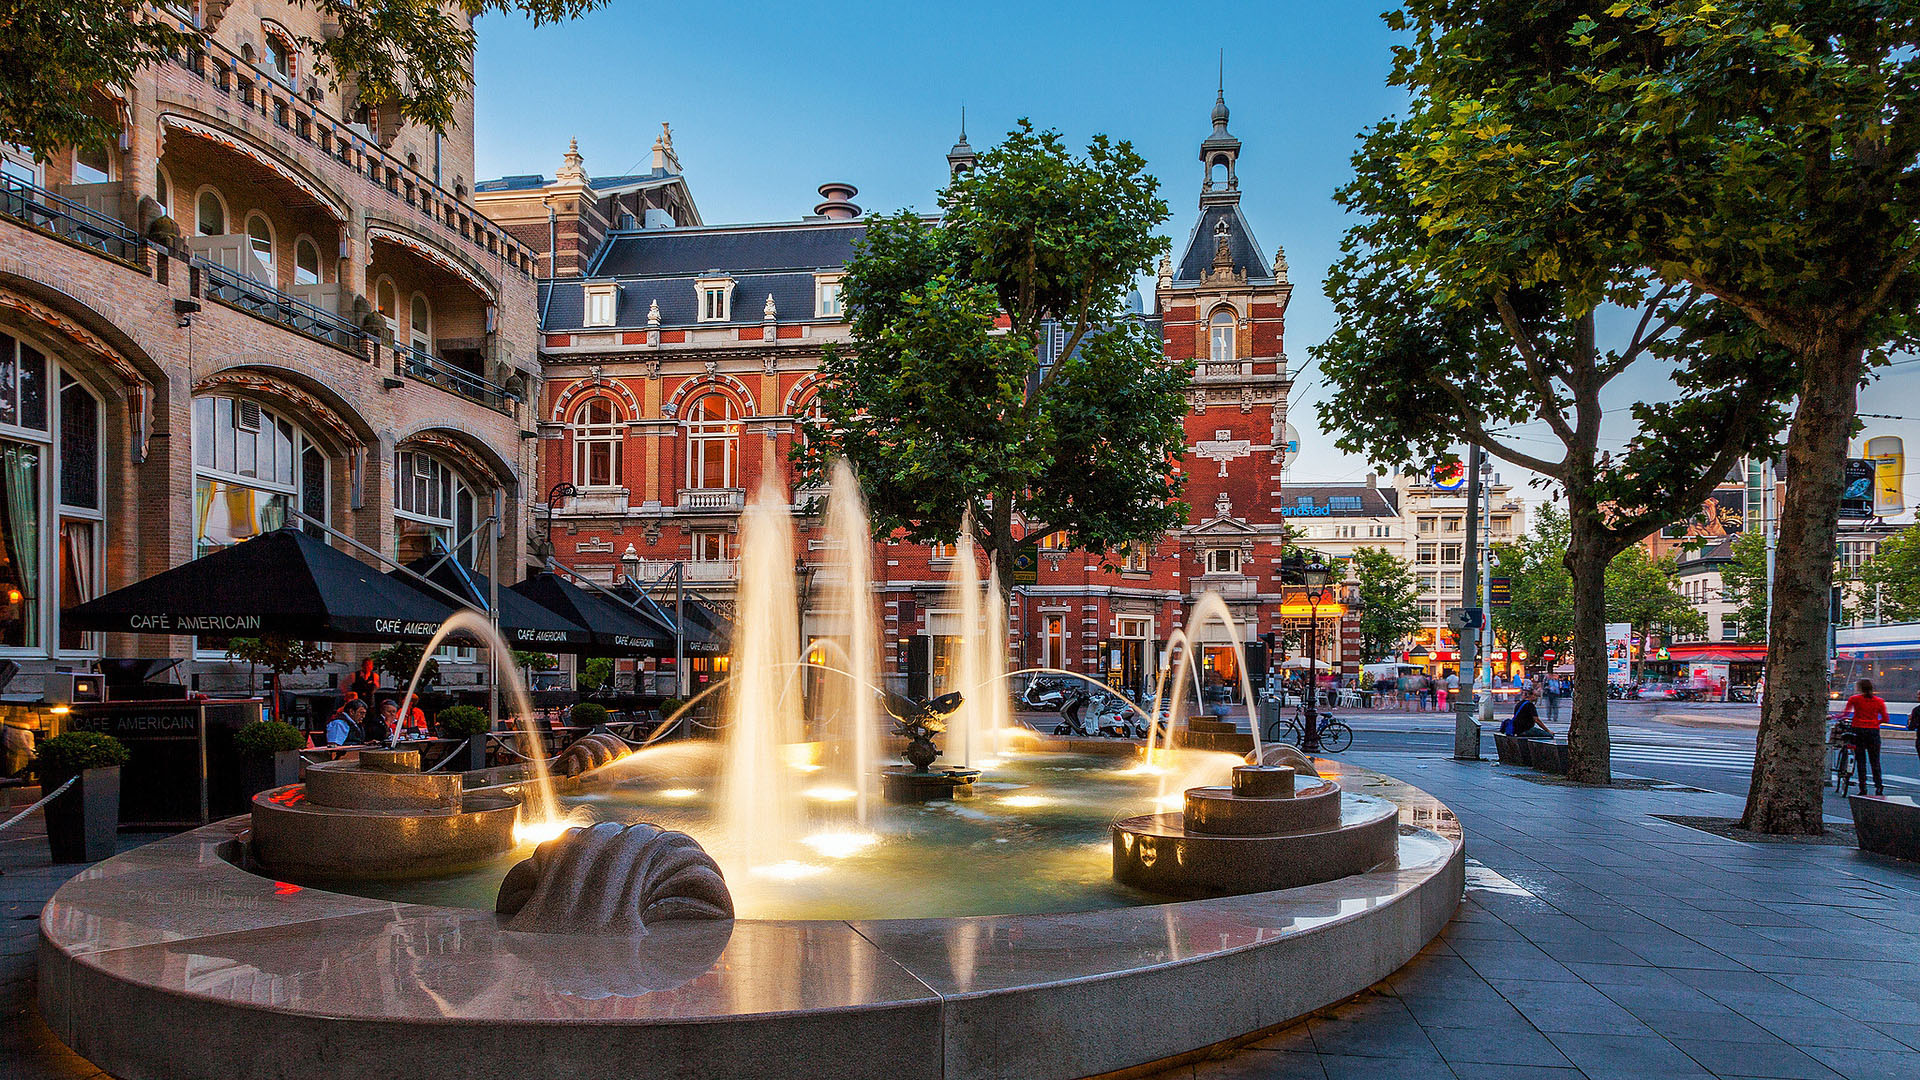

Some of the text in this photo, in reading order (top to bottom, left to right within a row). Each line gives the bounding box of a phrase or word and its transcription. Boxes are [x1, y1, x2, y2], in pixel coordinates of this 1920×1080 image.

[1281, 503, 1330, 517] andstad
[130, 613, 261, 629] CAFÉ AMERICAIN
[375, 618, 402, 633] CAFÉ
[517, 628, 535, 641] CAFÉ
[615, 635, 630, 647] CAFÉ
[118, 716, 194, 730] AMERICAIN
